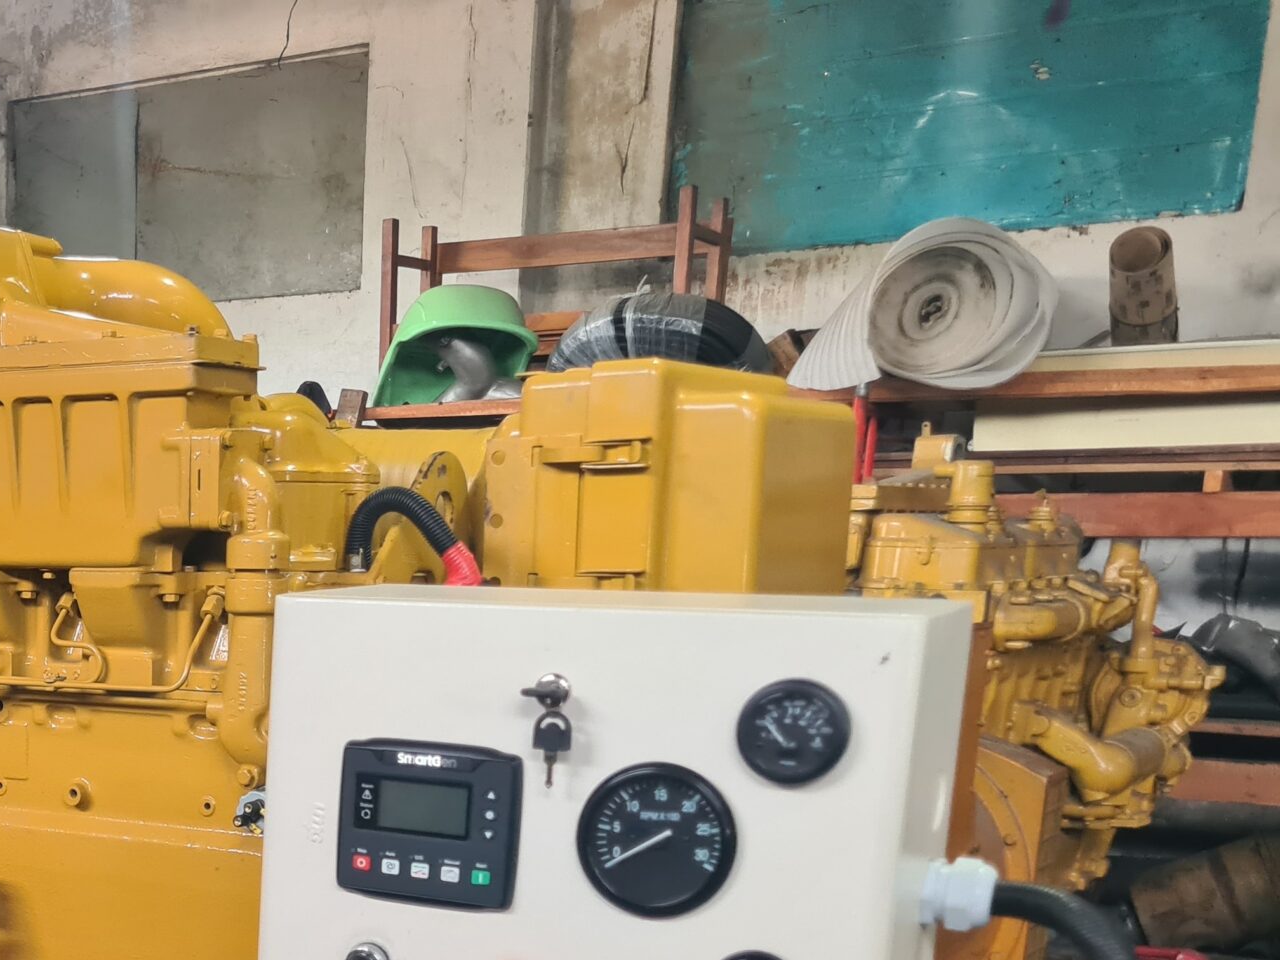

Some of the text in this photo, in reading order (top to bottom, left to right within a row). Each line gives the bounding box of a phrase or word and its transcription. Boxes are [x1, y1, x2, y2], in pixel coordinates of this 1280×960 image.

[397, 751, 457, 769] SmartGen
[654, 788, 668, 802] 15
[626, 800, 640, 813] 10
[681, 800, 697, 813] 20
[612, 821, 621, 833] 5
[696, 823, 711, 836] 25
[612, 846, 621, 858] 0
